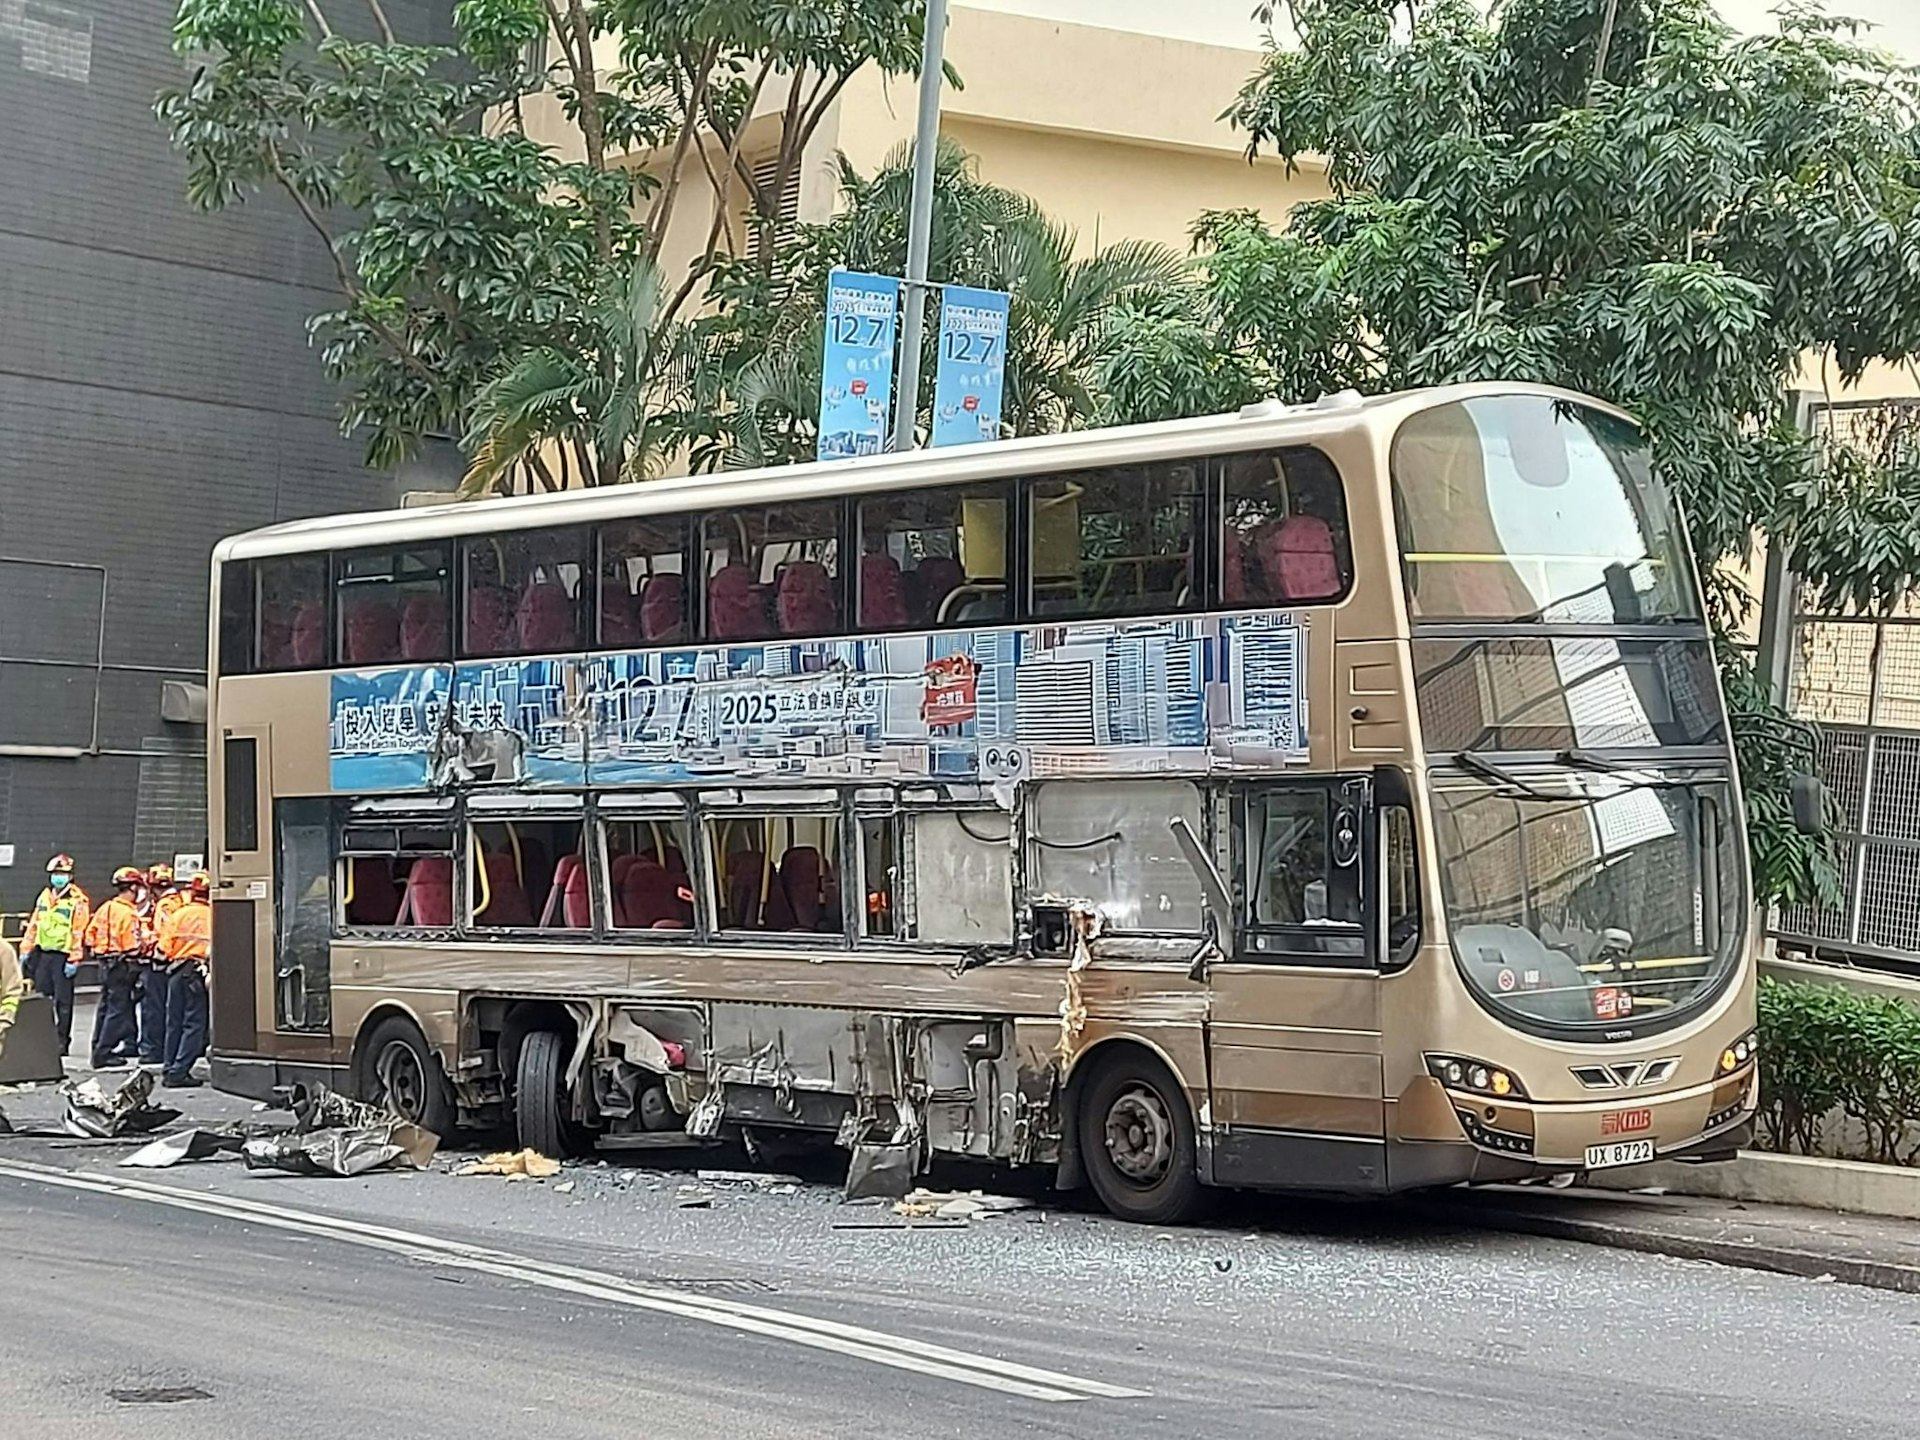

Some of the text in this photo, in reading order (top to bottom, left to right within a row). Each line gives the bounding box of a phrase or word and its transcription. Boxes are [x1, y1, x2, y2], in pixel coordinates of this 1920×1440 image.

[722, 693, 777, 725] 2025
[1616, 1109, 1651, 1133] KMB
[1588, 1142, 1650, 1165] UX 8722
